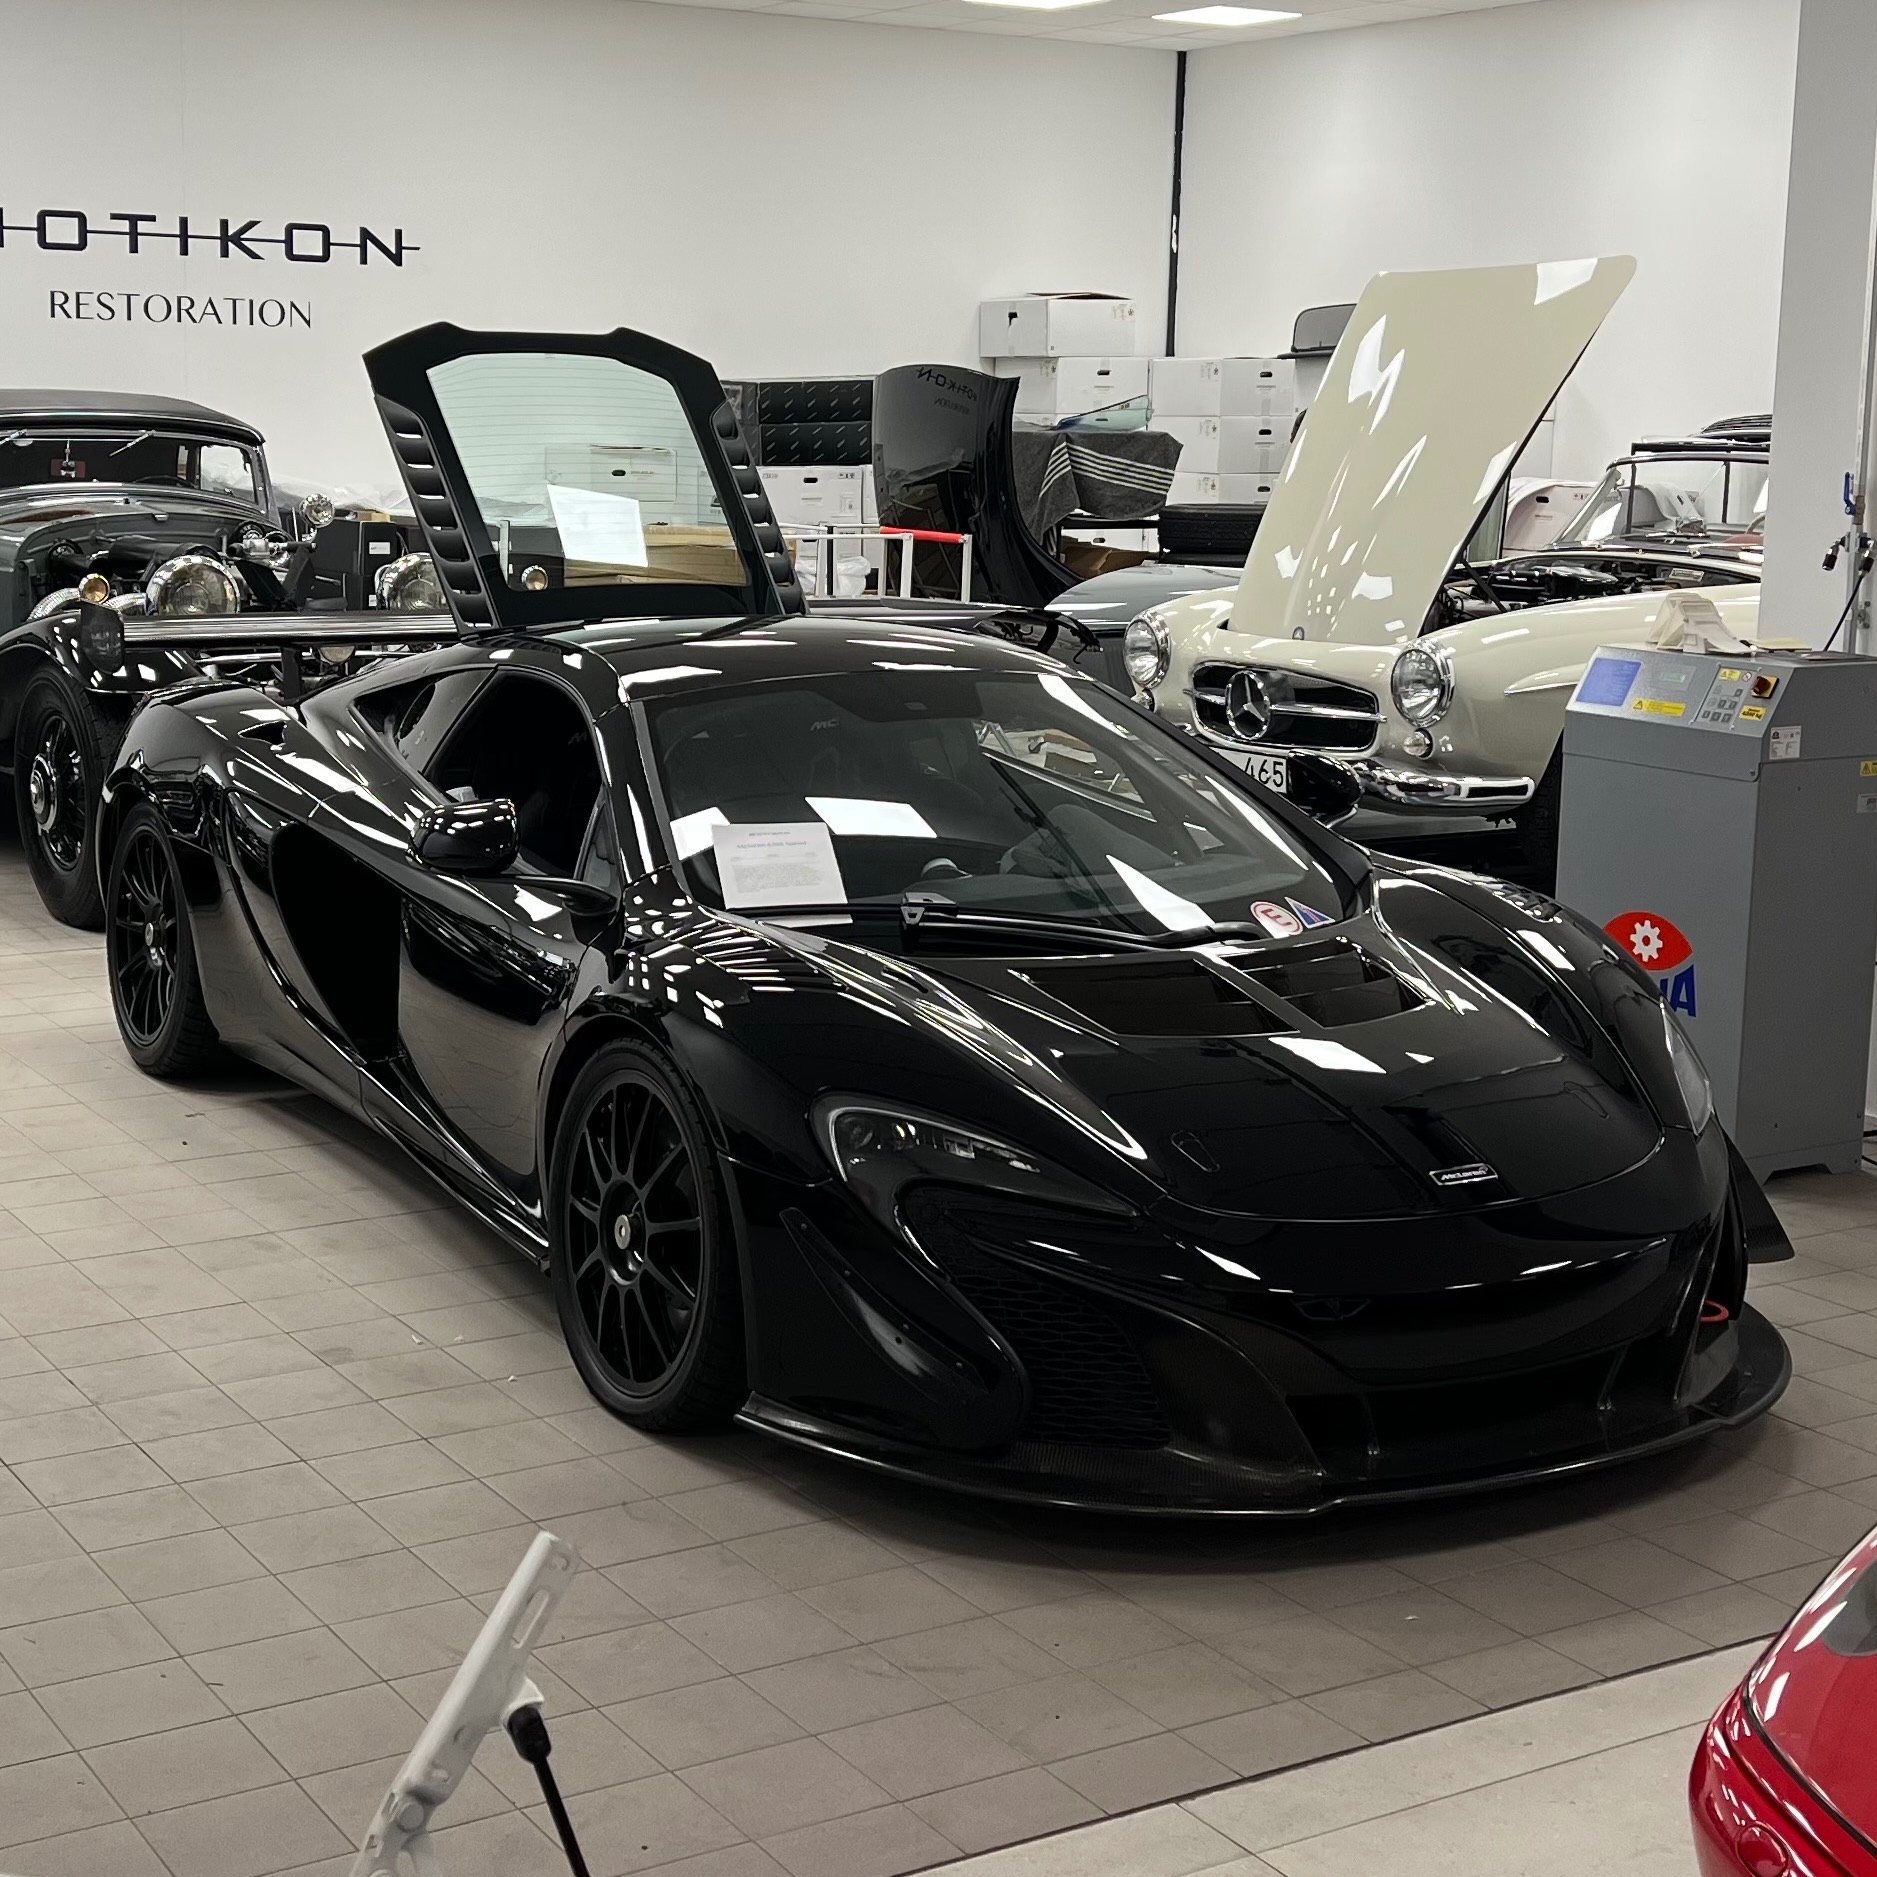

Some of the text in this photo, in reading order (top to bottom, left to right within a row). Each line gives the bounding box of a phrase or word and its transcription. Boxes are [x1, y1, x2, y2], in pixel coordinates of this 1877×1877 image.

[0, 207, 403, 267] OTIKON
[50, 290, 311, 328] RESTORATION
[1245, 757, 1284, 788] 465
[1441, 1168, 1488, 1180] McLaren
